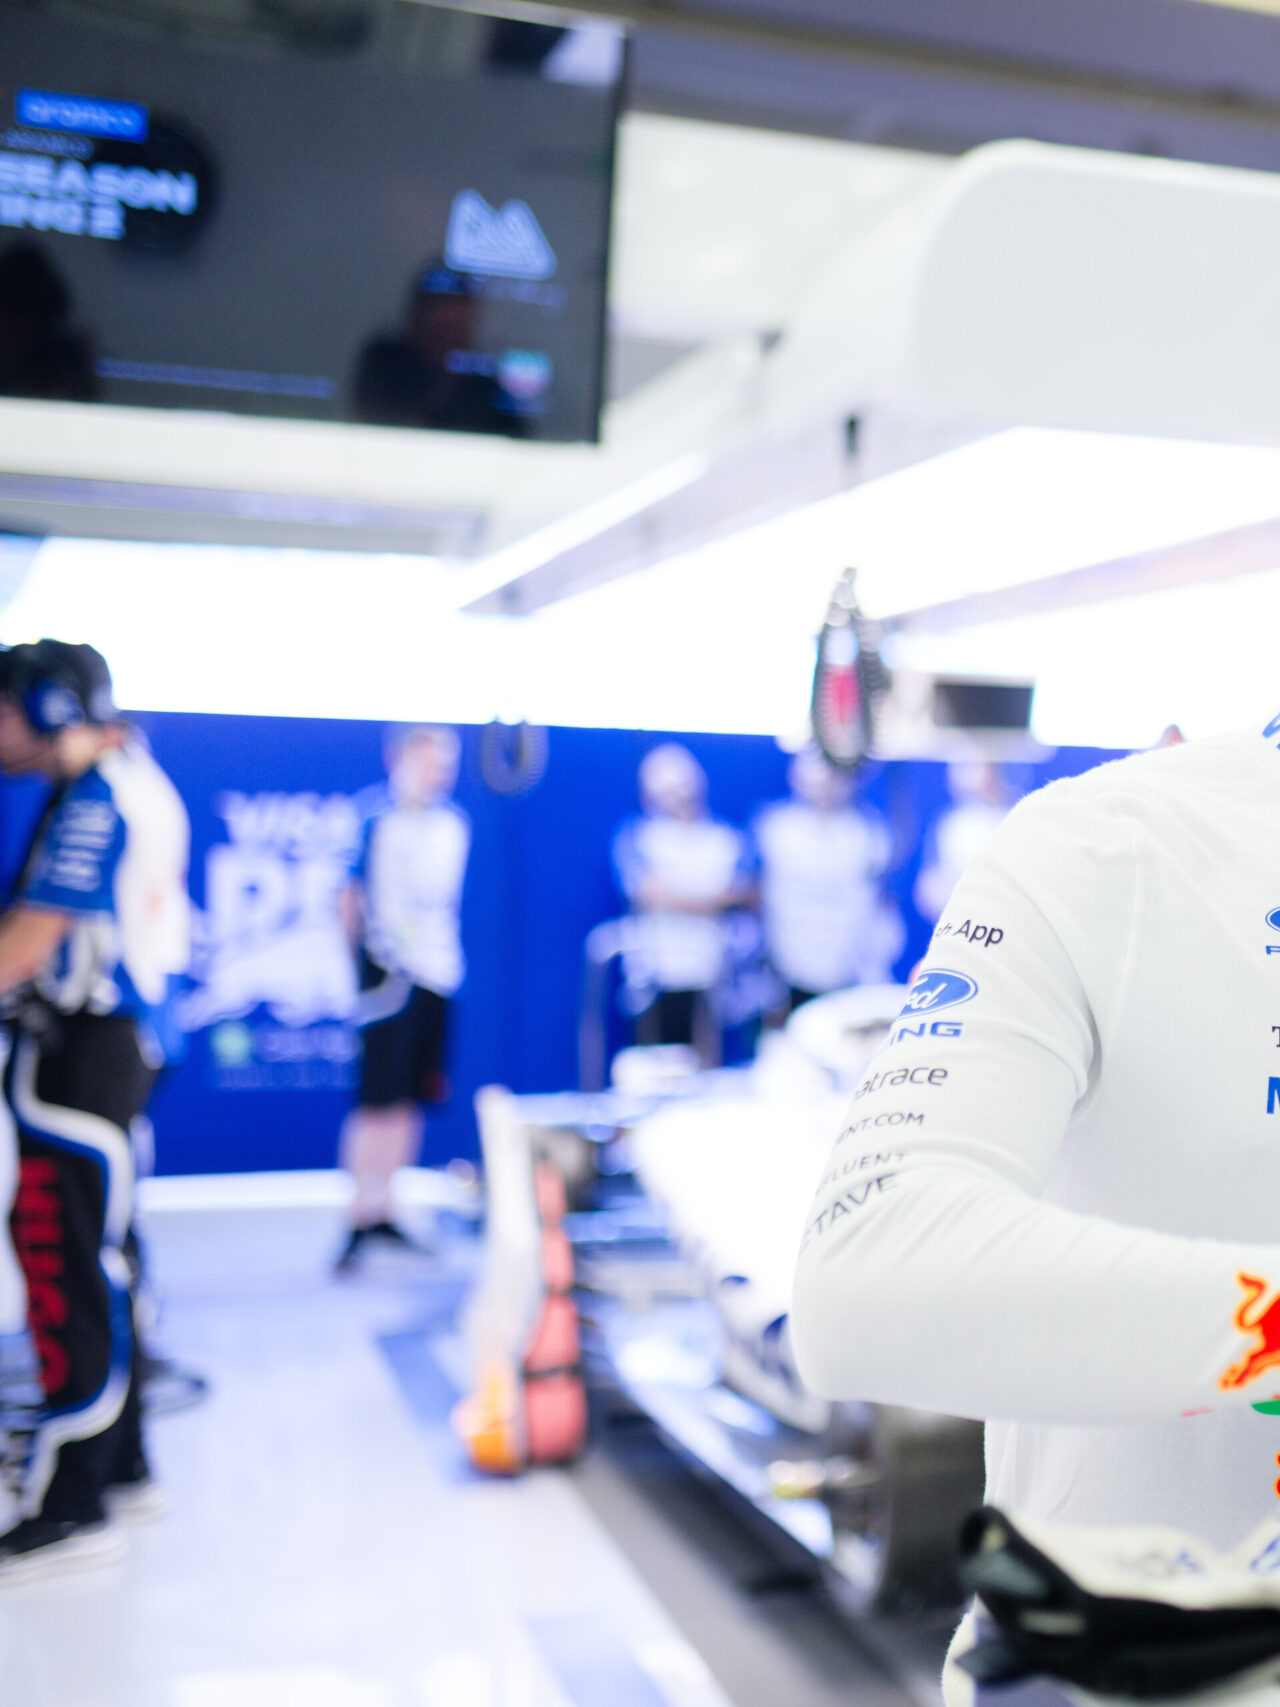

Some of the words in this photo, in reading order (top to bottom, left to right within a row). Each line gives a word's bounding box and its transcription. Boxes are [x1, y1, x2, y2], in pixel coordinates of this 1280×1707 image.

[952, 919, 1004, 948] App
[888, 1021, 963, 1047] ING
[854, 1066, 948, 1100] atrace
[812, 1172, 901, 1236] TAVE
